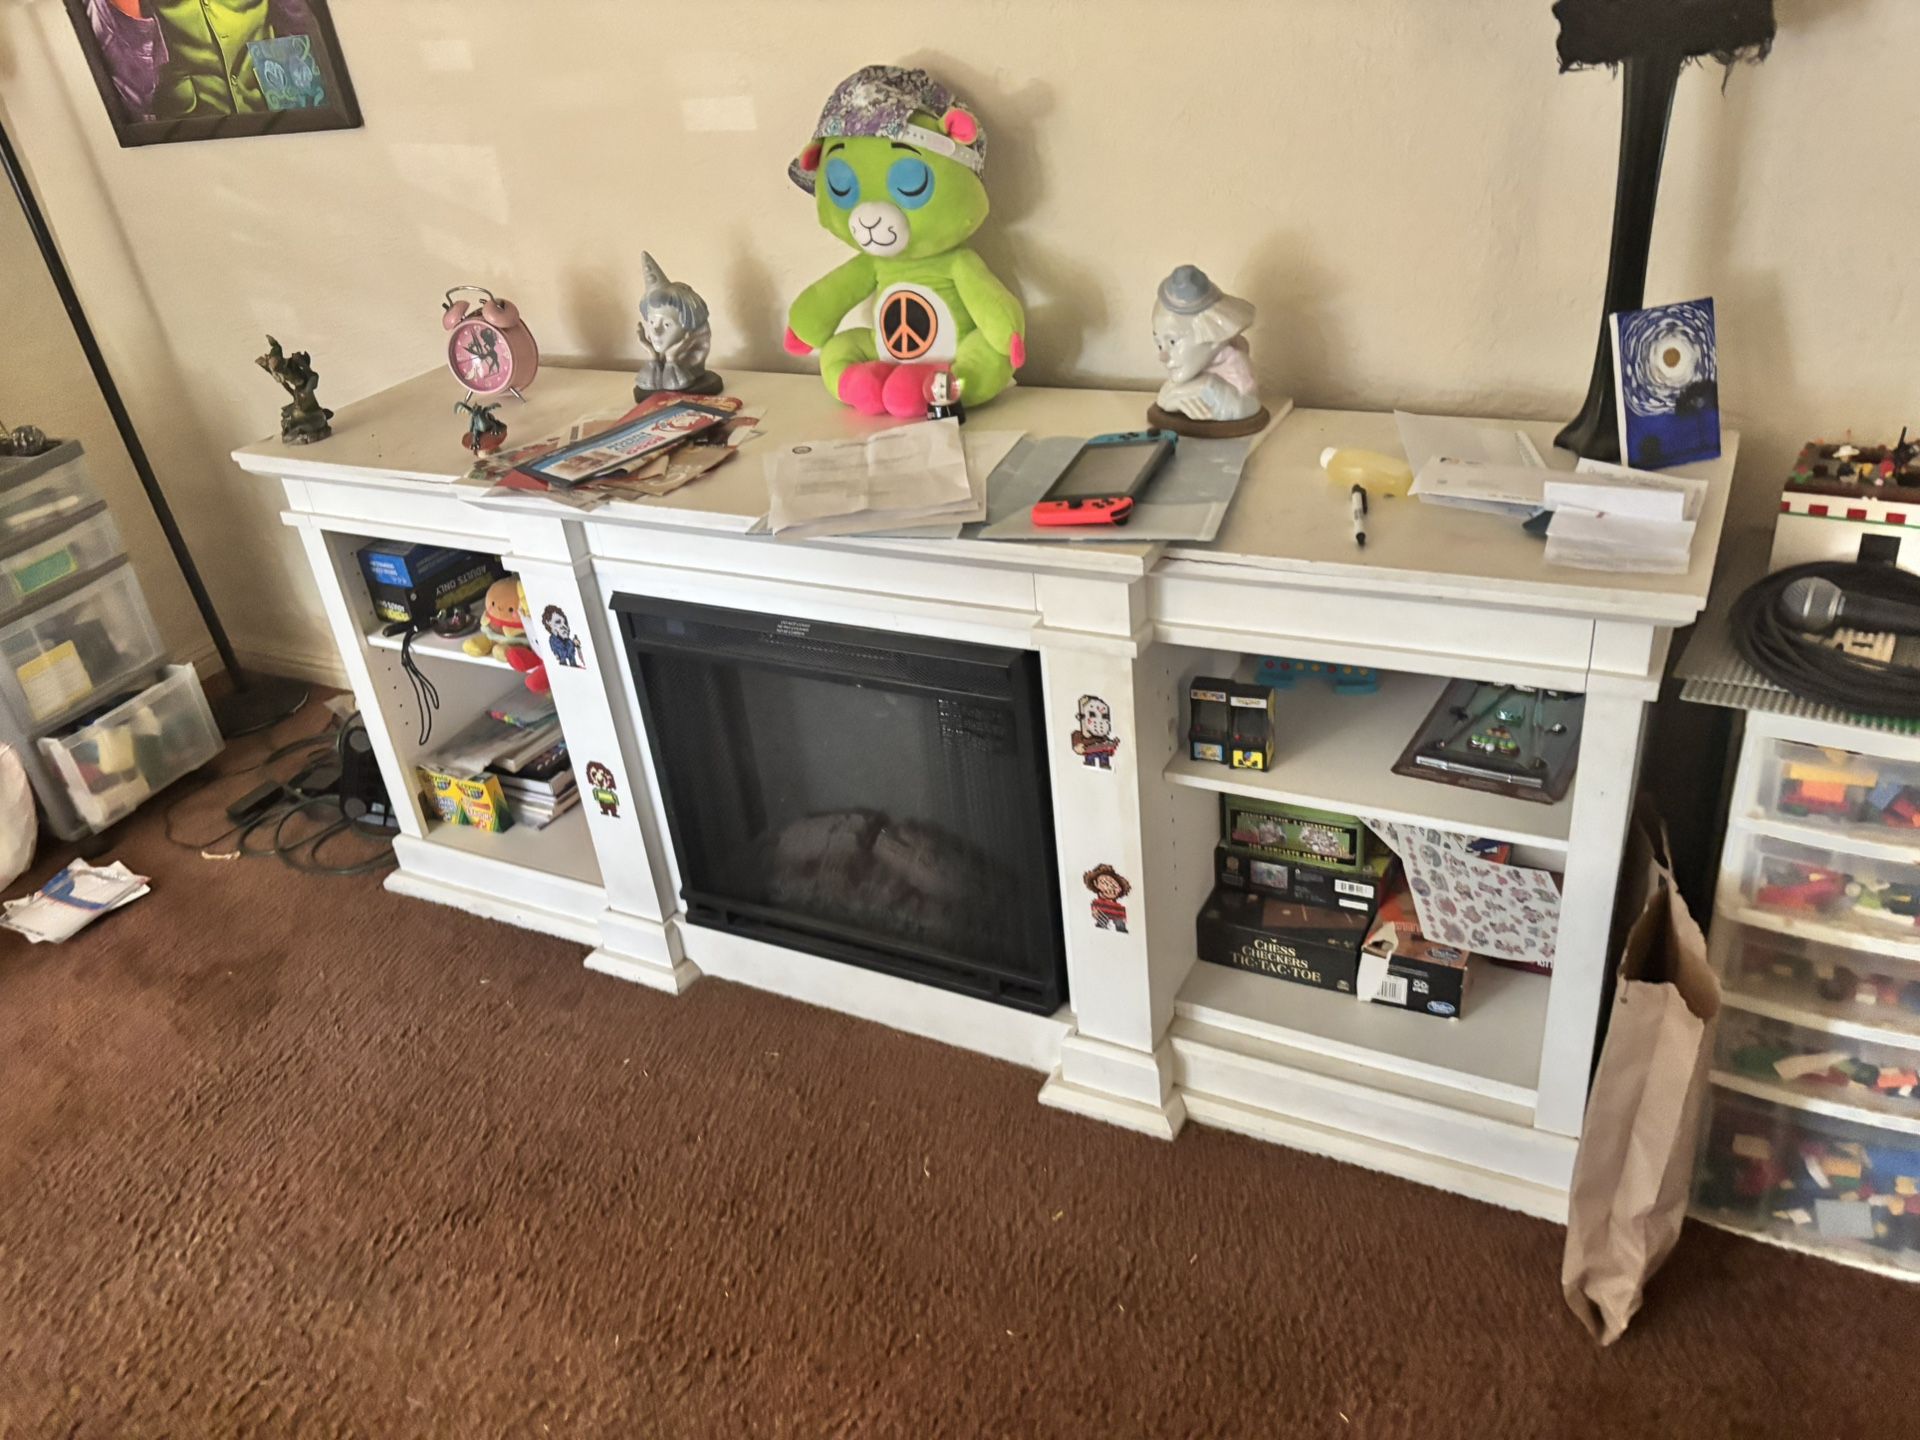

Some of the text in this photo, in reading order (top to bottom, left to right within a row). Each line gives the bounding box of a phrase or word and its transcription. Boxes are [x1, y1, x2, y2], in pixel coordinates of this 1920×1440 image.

[436, 580, 457, 596] ONLY
[1242, 945, 1309, 969] CHECKERS
[1254, 939, 1296, 957] CHESS
